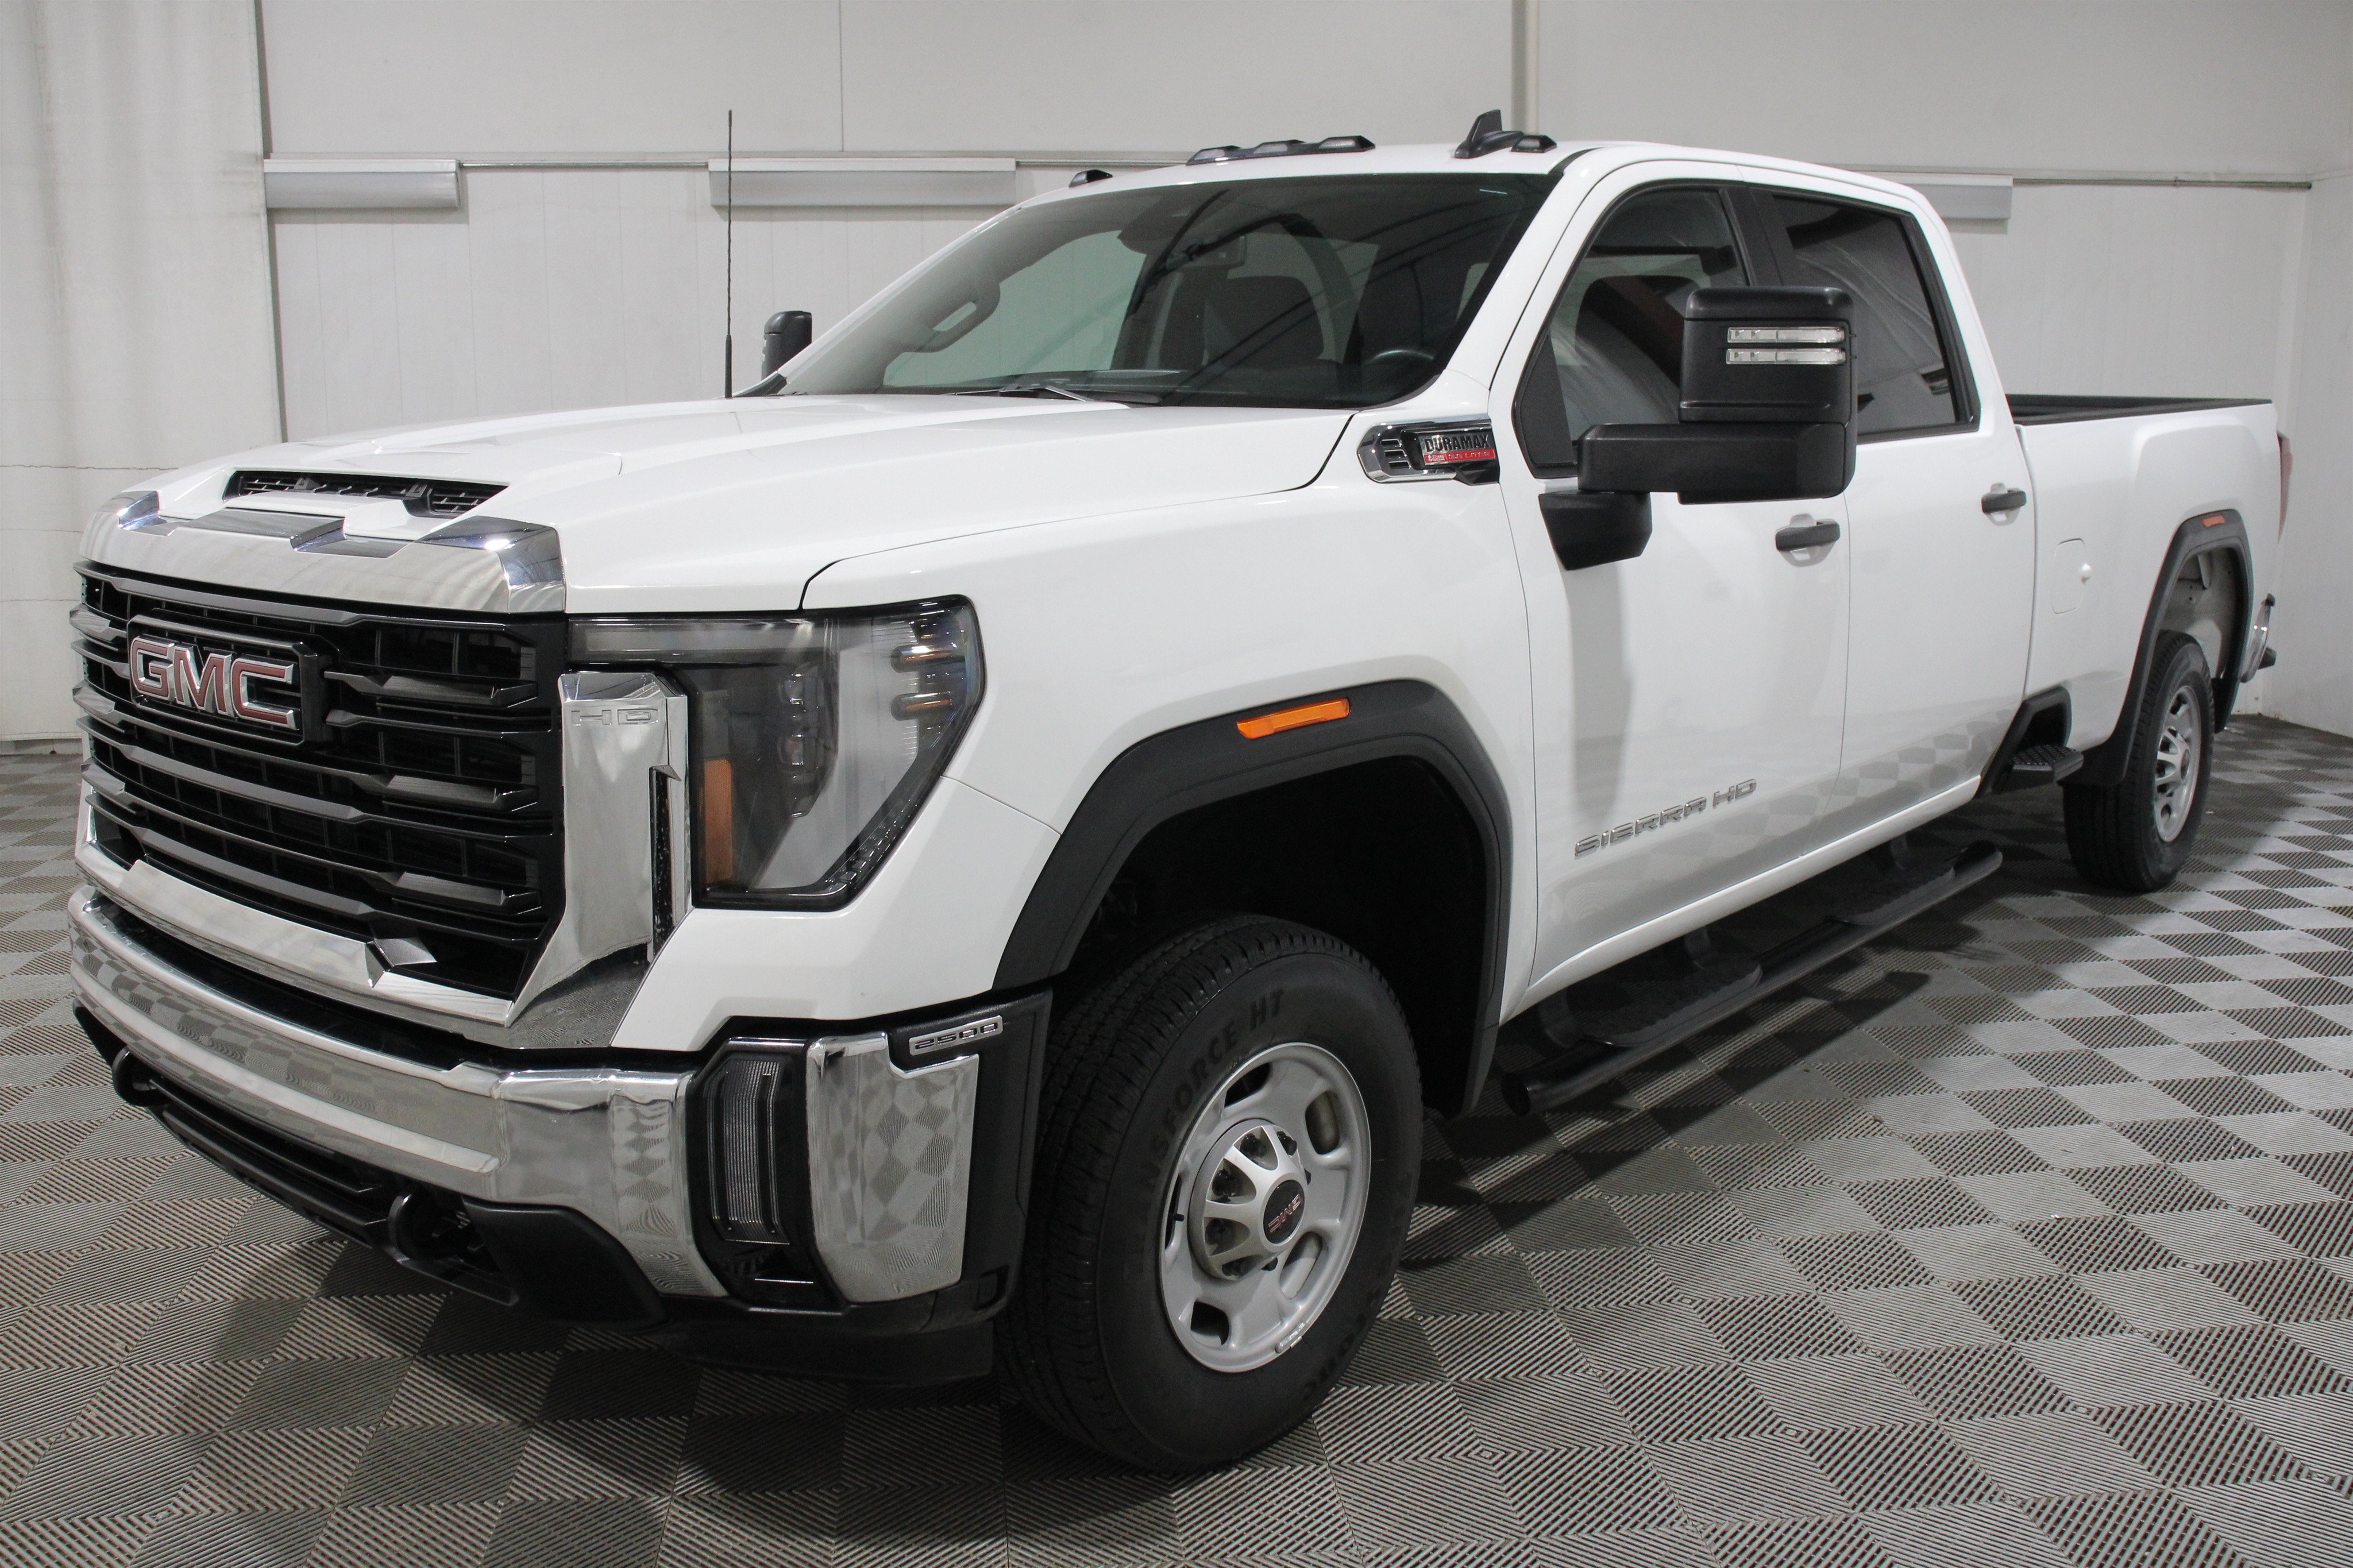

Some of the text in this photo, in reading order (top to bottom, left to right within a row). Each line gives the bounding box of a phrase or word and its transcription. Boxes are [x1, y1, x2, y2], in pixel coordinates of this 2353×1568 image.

[1424, 435, 1491, 453] DURAMAX
[130, 634, 298, 730] GMC
[571, 708, 659, 726] HD
[1574, 778, 1757, 859] SIERRA HD
[1249, 989, 1284, 1031] HT
[915, 1023, 998, 1050] 2500
[1268, 1193, 1302, 1233] GMC
